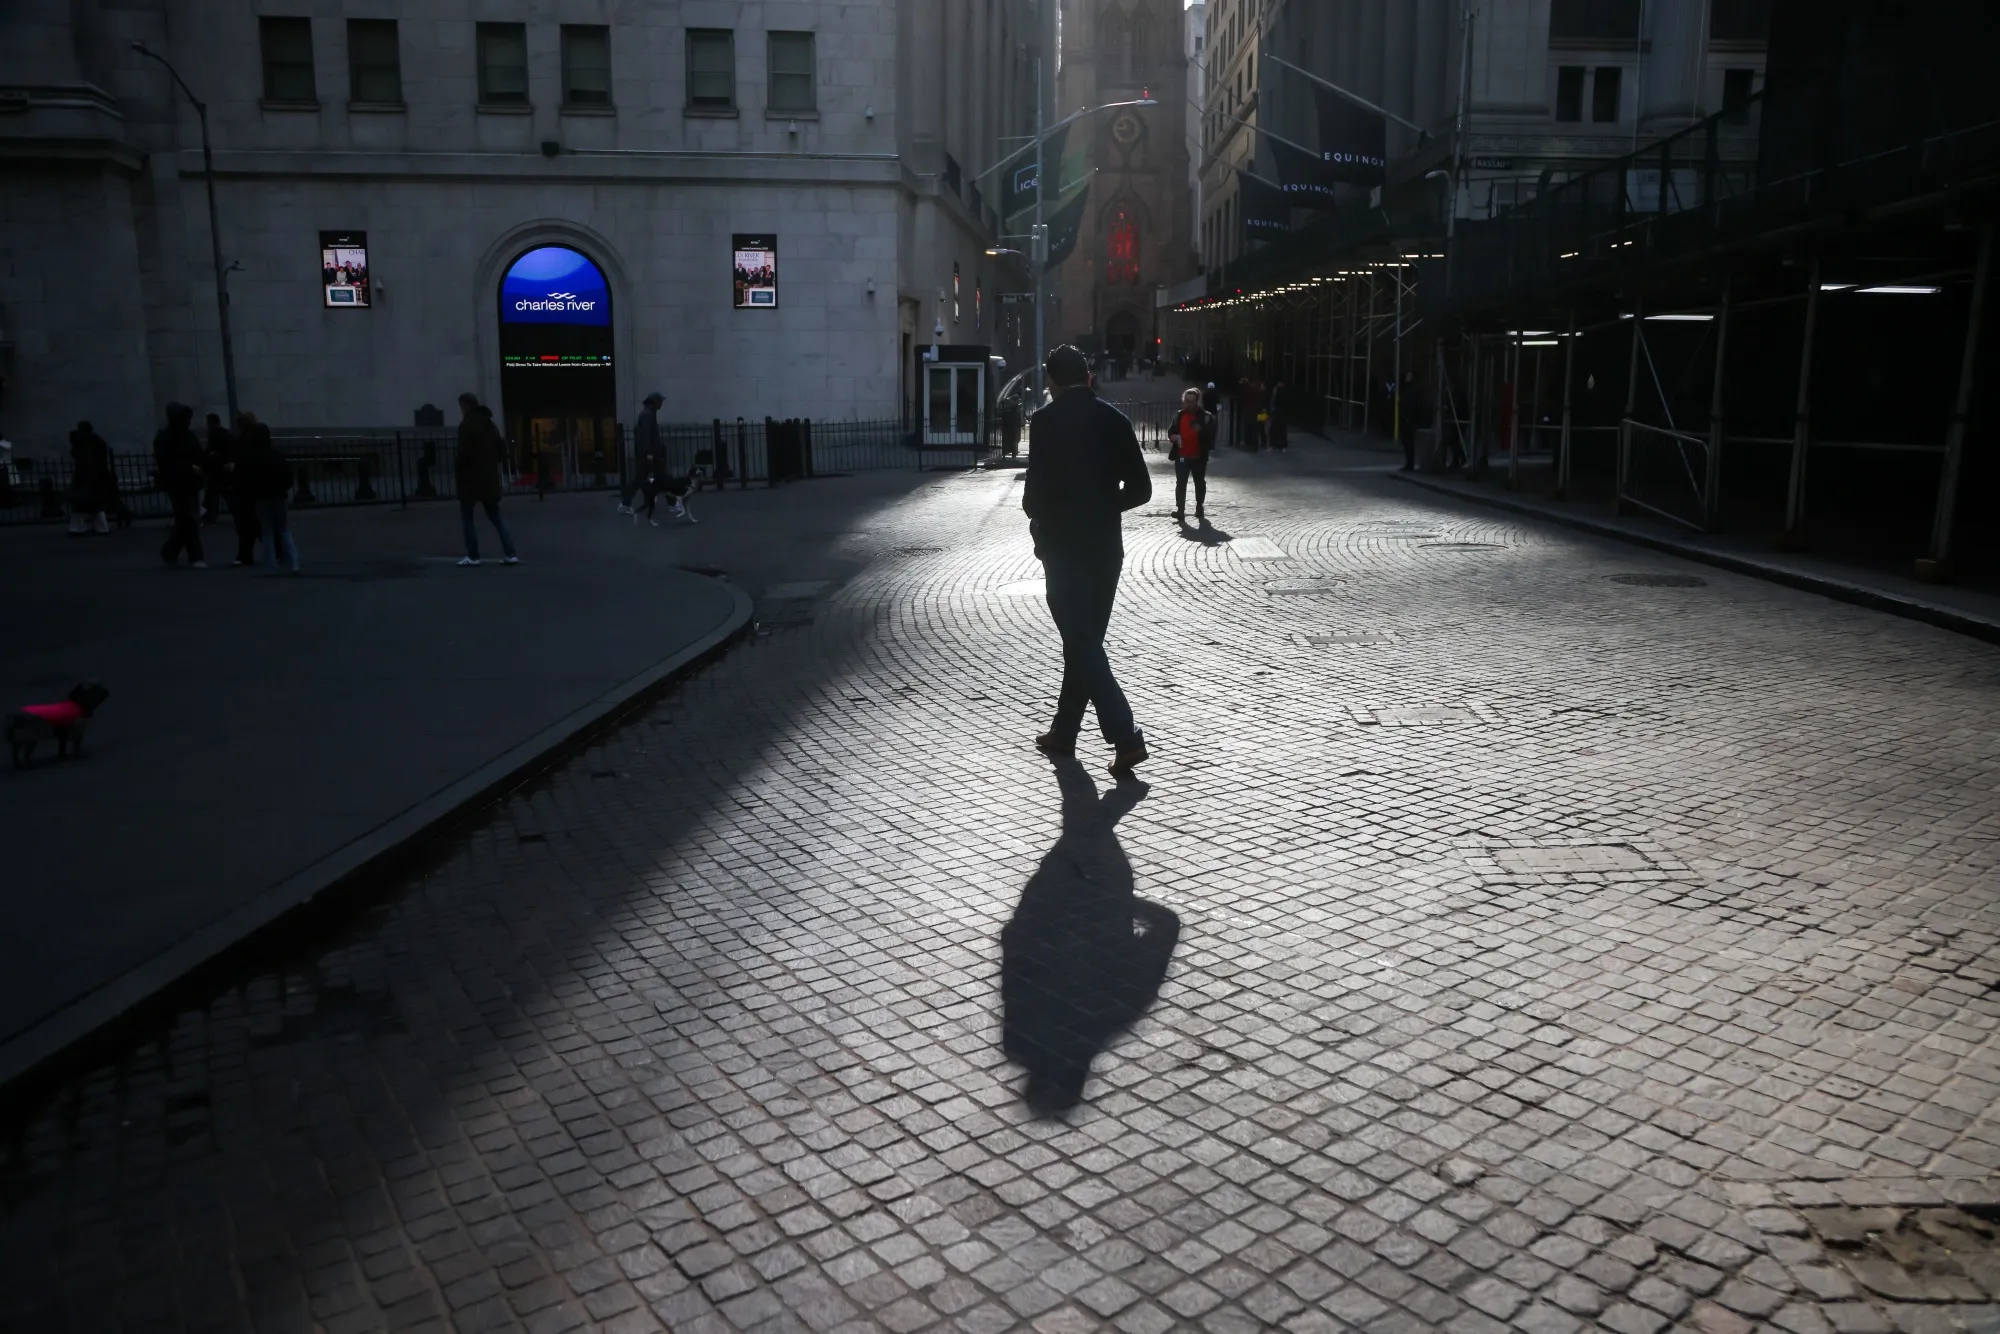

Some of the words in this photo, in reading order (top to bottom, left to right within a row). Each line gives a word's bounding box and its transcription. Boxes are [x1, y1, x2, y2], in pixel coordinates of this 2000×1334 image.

[1324, 152, 1385, 167] EQUINOX
[1020, 177, 1038, 192] ICE
[1283, 183, 1334, 196] EQUINOX
[1247, 218, 1289, 231] EQUINOX
[515, 299, 564, 311] charles
[567, 299, 596, 311] river
